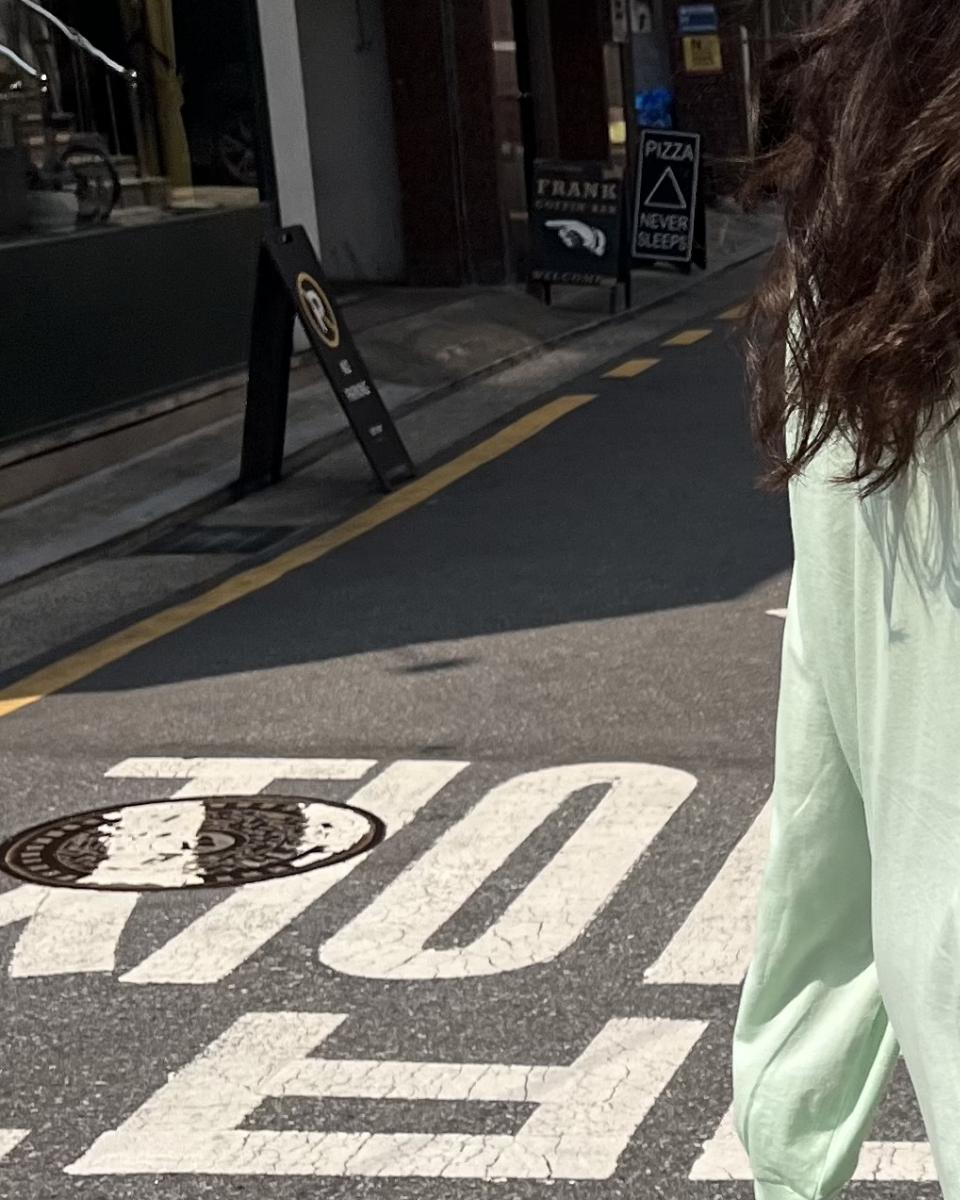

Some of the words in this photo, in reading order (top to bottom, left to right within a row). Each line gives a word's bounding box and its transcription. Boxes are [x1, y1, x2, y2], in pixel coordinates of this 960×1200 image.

[644, 139, 694, 161] PIZZA
[537, 178, 617, 199] FRANK
[639, 211, 689, 232] NEVER
[637, 231, 689, 251] SLEEPS
